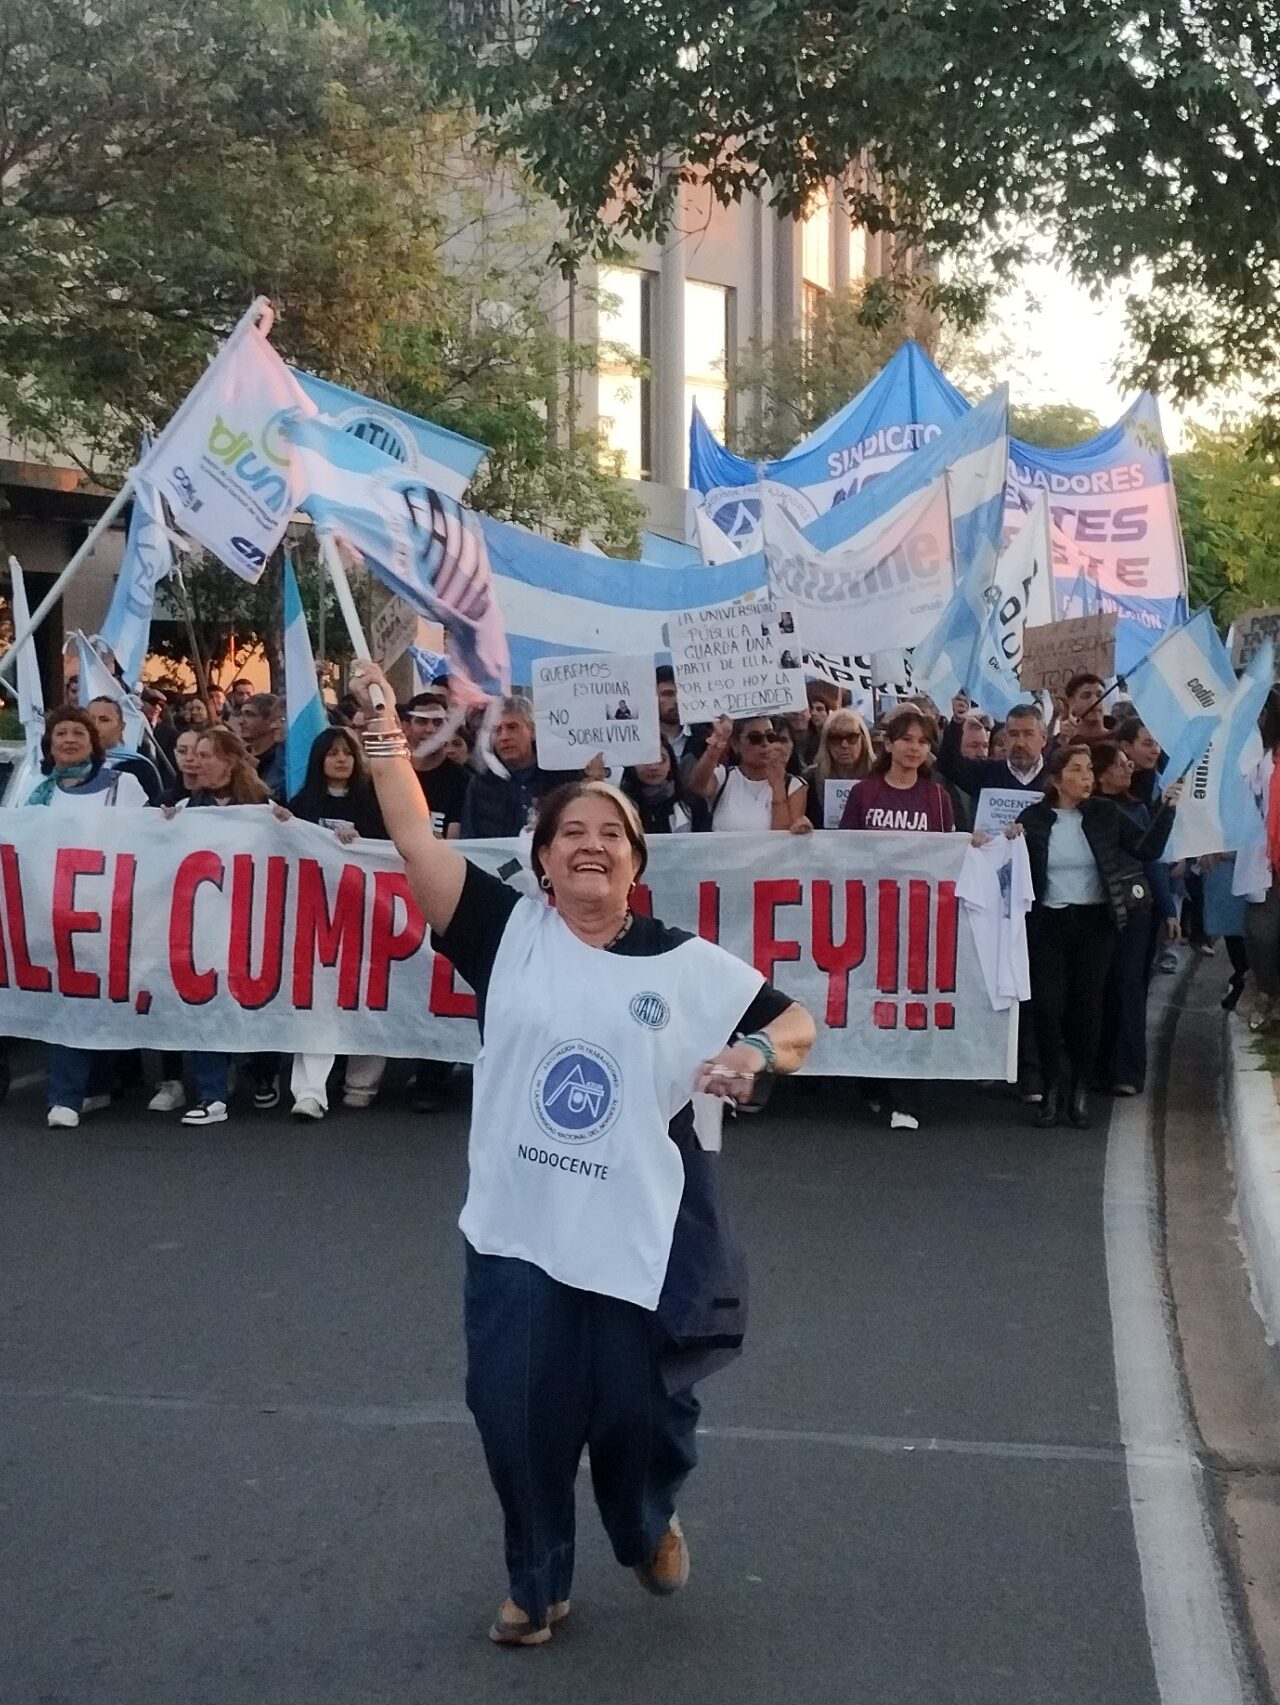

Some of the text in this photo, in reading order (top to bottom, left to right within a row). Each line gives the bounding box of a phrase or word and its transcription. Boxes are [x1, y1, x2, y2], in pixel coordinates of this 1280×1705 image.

[827, 424, 942, 477] SINDICATO
[678, 612, 694, 626] LA
[684, 637, 774, 660] GUARDA UNA
[540, 663, 611, 682] QUEREMOS
[720, 661, 734, 670] DE
[573, 681, 630, 696] ESTUDIAR
[743, 673, 768, 687] HOY
[775, 672, 790, 685] LA
[713, 698, 721, 708] A
[723, 686, 793, 711] DEFENDER
[549, 710, 569, 725] NO
[568, 725, 640, 744] SOBREVIVIR
[865, 808, 928, 831] FRANJA
[518, 1144, 609, 1180] NODOCENTE
